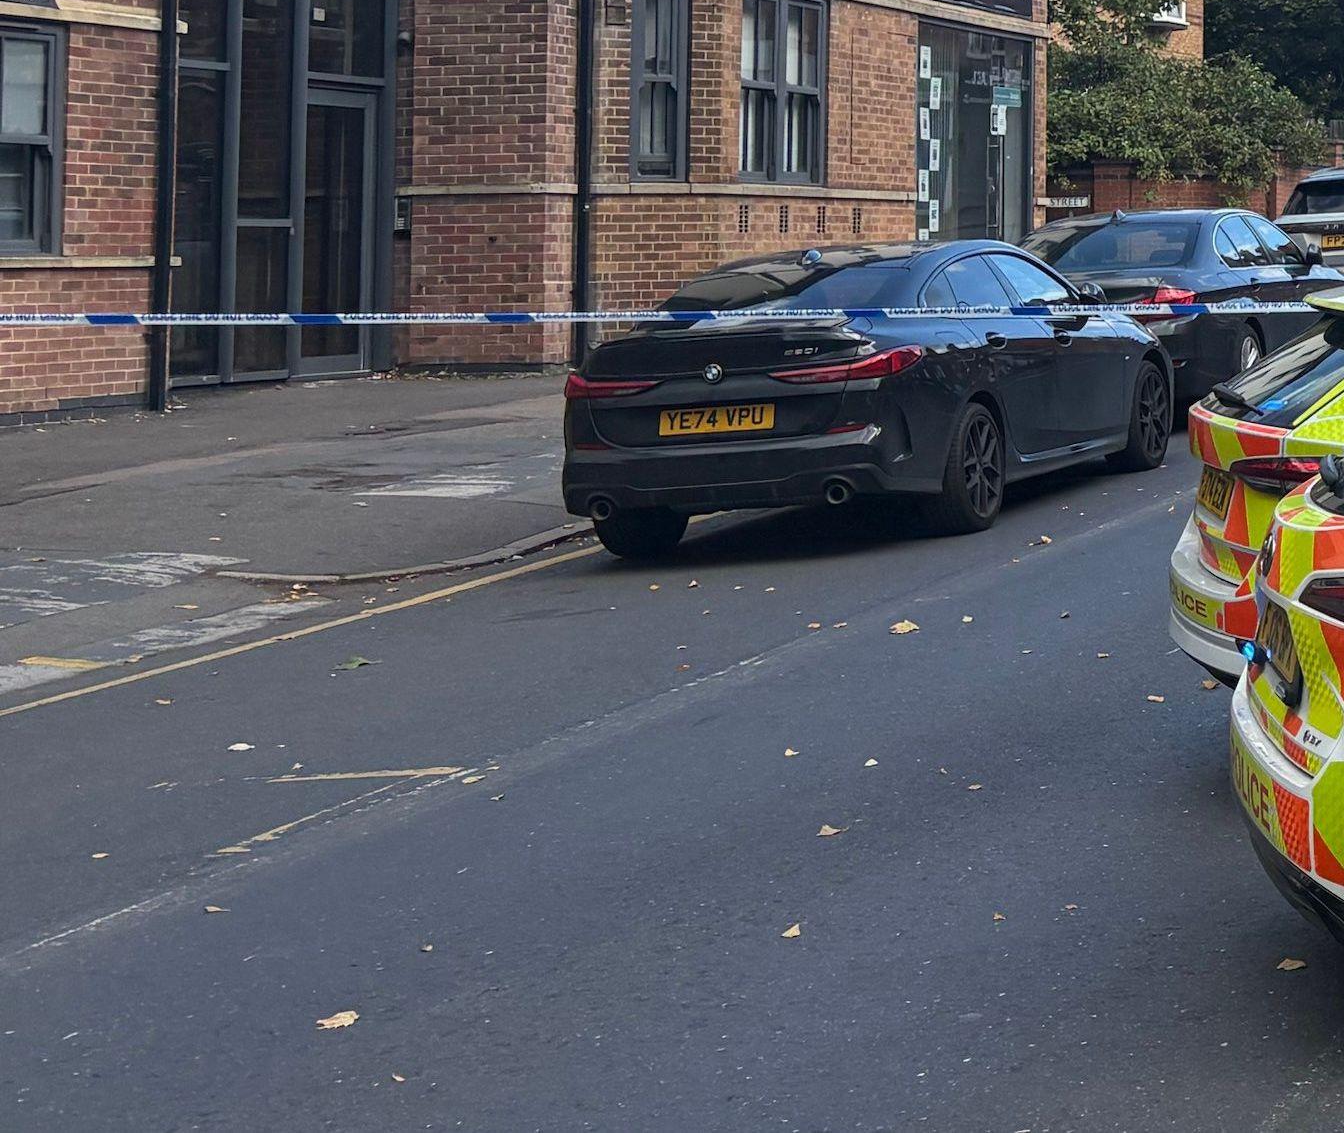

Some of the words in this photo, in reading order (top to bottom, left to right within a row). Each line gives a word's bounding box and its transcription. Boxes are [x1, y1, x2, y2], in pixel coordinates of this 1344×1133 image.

[1050, 196, 1084, 207] STREET
[666, 409, 718, 431] YE74
[726, 406, 764, 426] VPU
